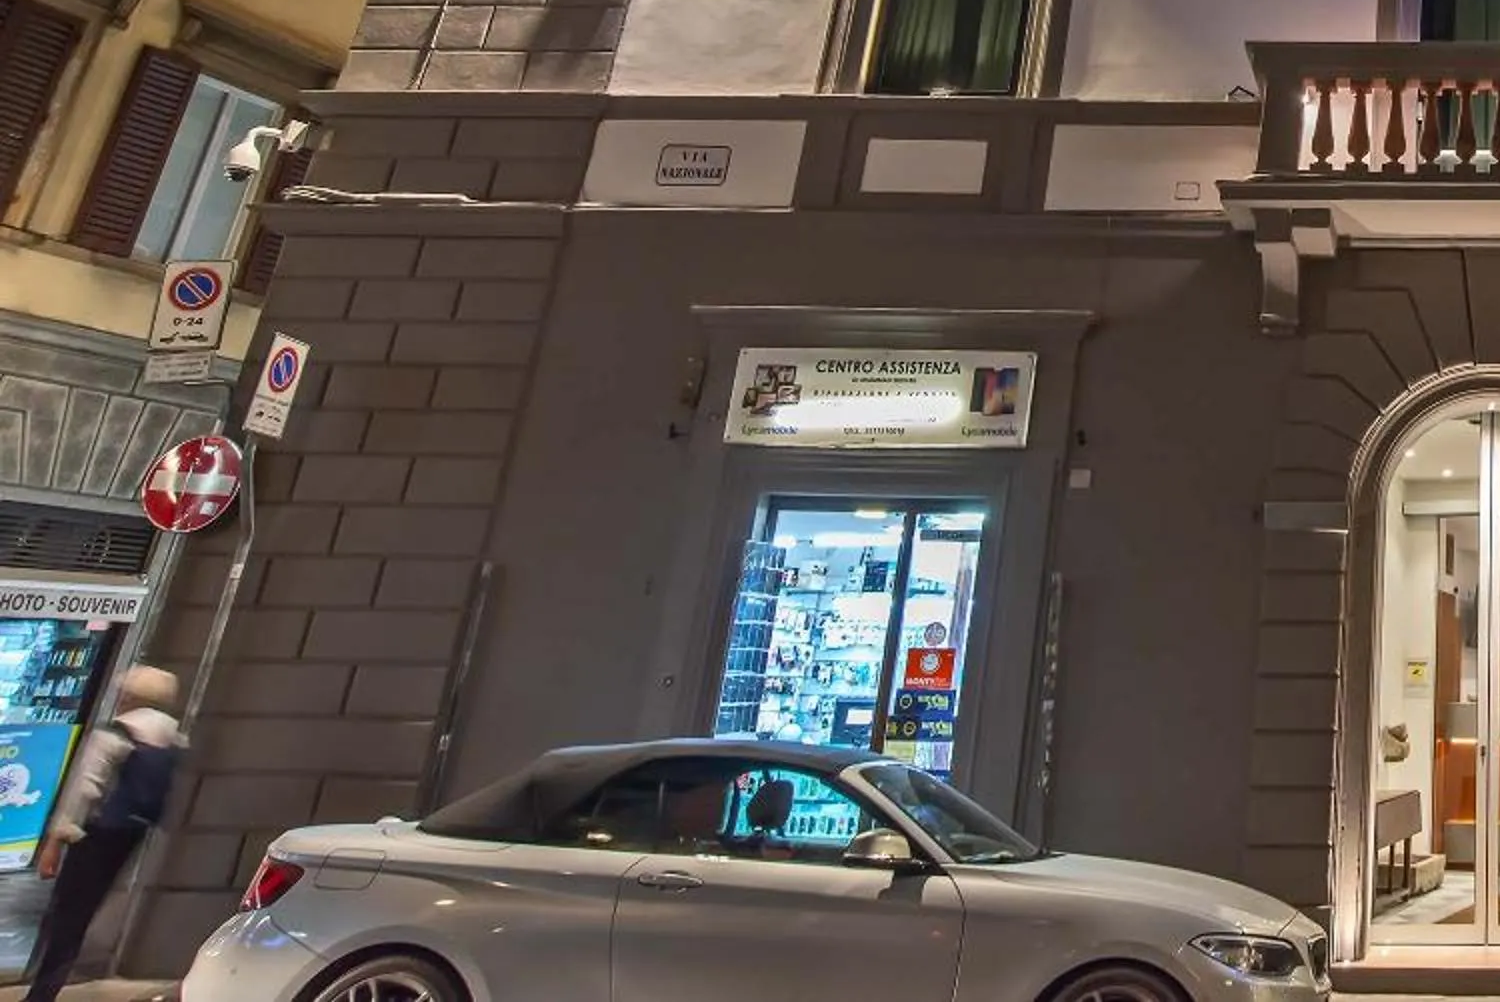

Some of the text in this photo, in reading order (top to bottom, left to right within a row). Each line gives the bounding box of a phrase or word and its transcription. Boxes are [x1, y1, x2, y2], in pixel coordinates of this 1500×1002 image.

[682, 151, 708, 163] VIA
[661, 167, 724, 179] NAZIONALE
[815, 359, 961, 376] CENTRO ASSISTENZA
[0, 592, 45, 611] HOTO
[57, 595, 137, 615] SOUVENIR
